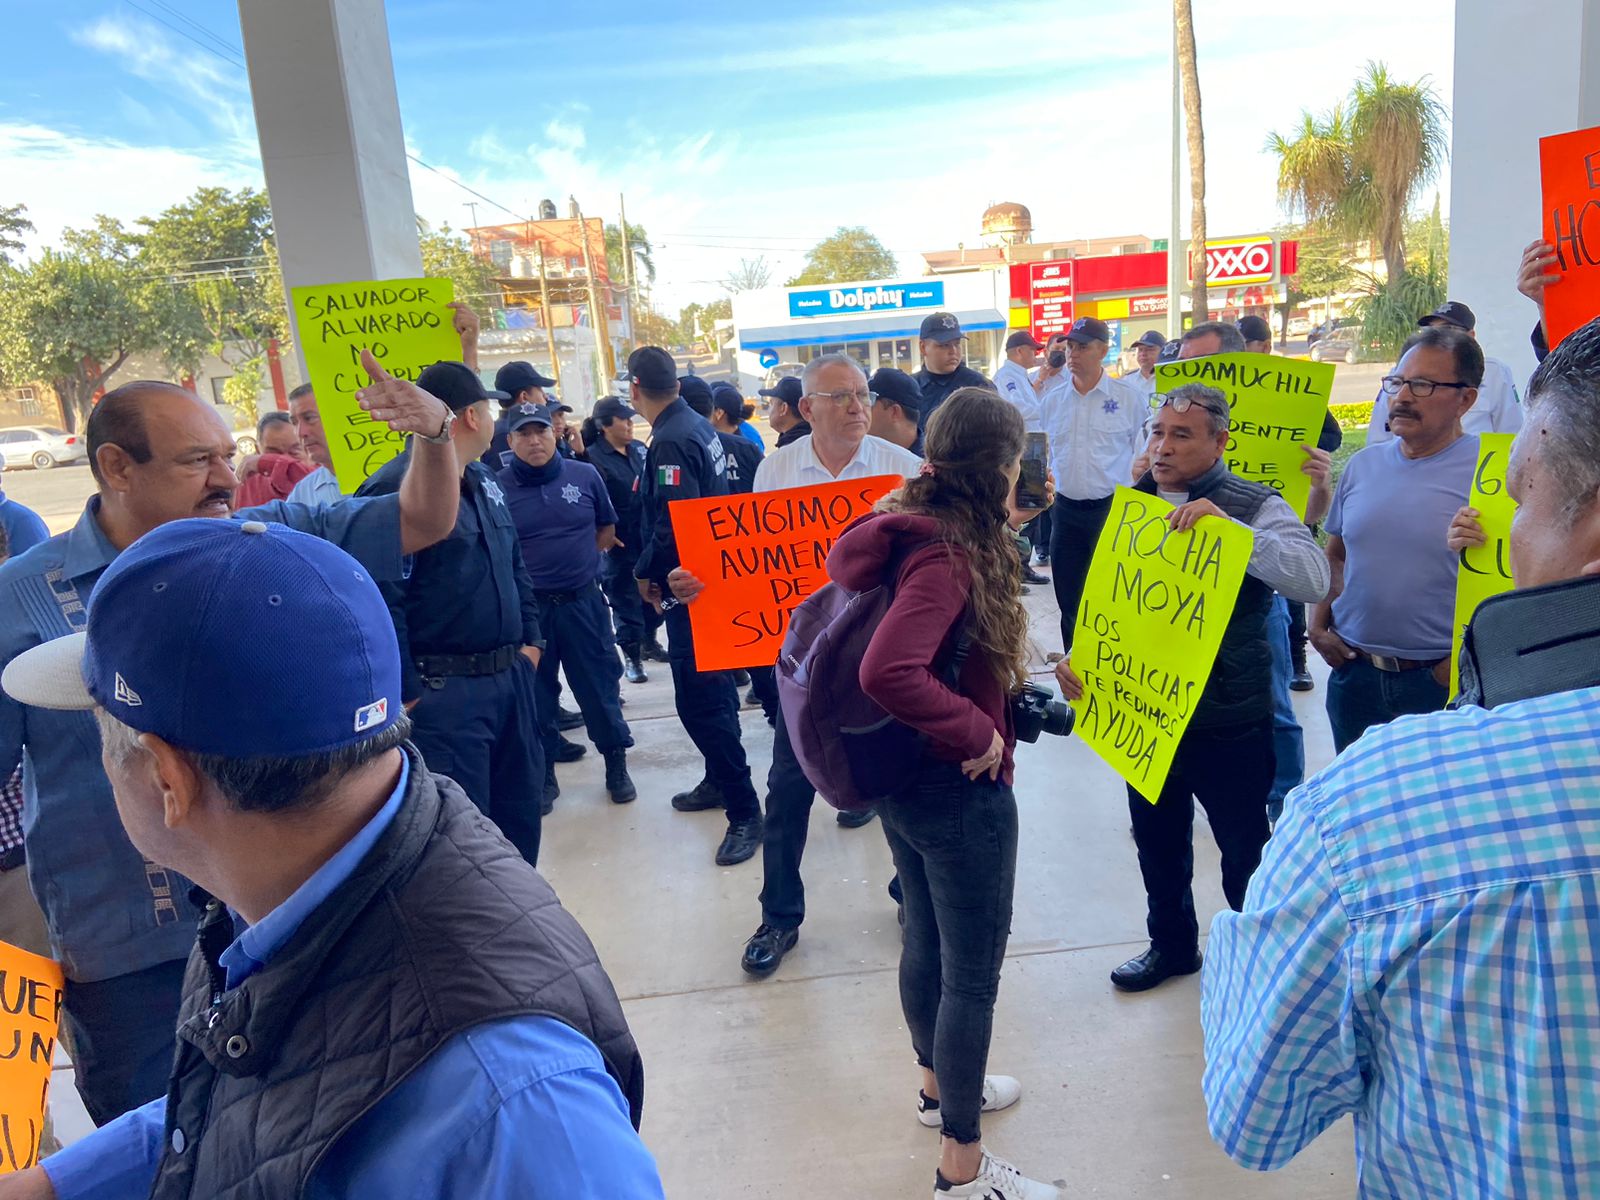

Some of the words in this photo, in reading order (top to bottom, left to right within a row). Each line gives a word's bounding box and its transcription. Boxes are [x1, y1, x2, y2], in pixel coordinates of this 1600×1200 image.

[305, 287, 436, 320] SALVADOR
[829, 287, 904, 310] Dolphy
[322, 311, 440, 343] ALVARADO
[1159, 362, 1324, 397] GUAMUCHIL
[1112, 500, 1222, 589] ROCHA
[769, 577, 812, 605] DE
[1112, 562, 1206, 640] MOYA
[1082, 600, 1121, 643] LOS
[1096, 640, 1195, 720] POLICIAS
[1082, 669, 1106, 692] TE
[1113, 681, 1179, 738] PEDIMOS
[1081, 692, 1157, 783] AYUDA
